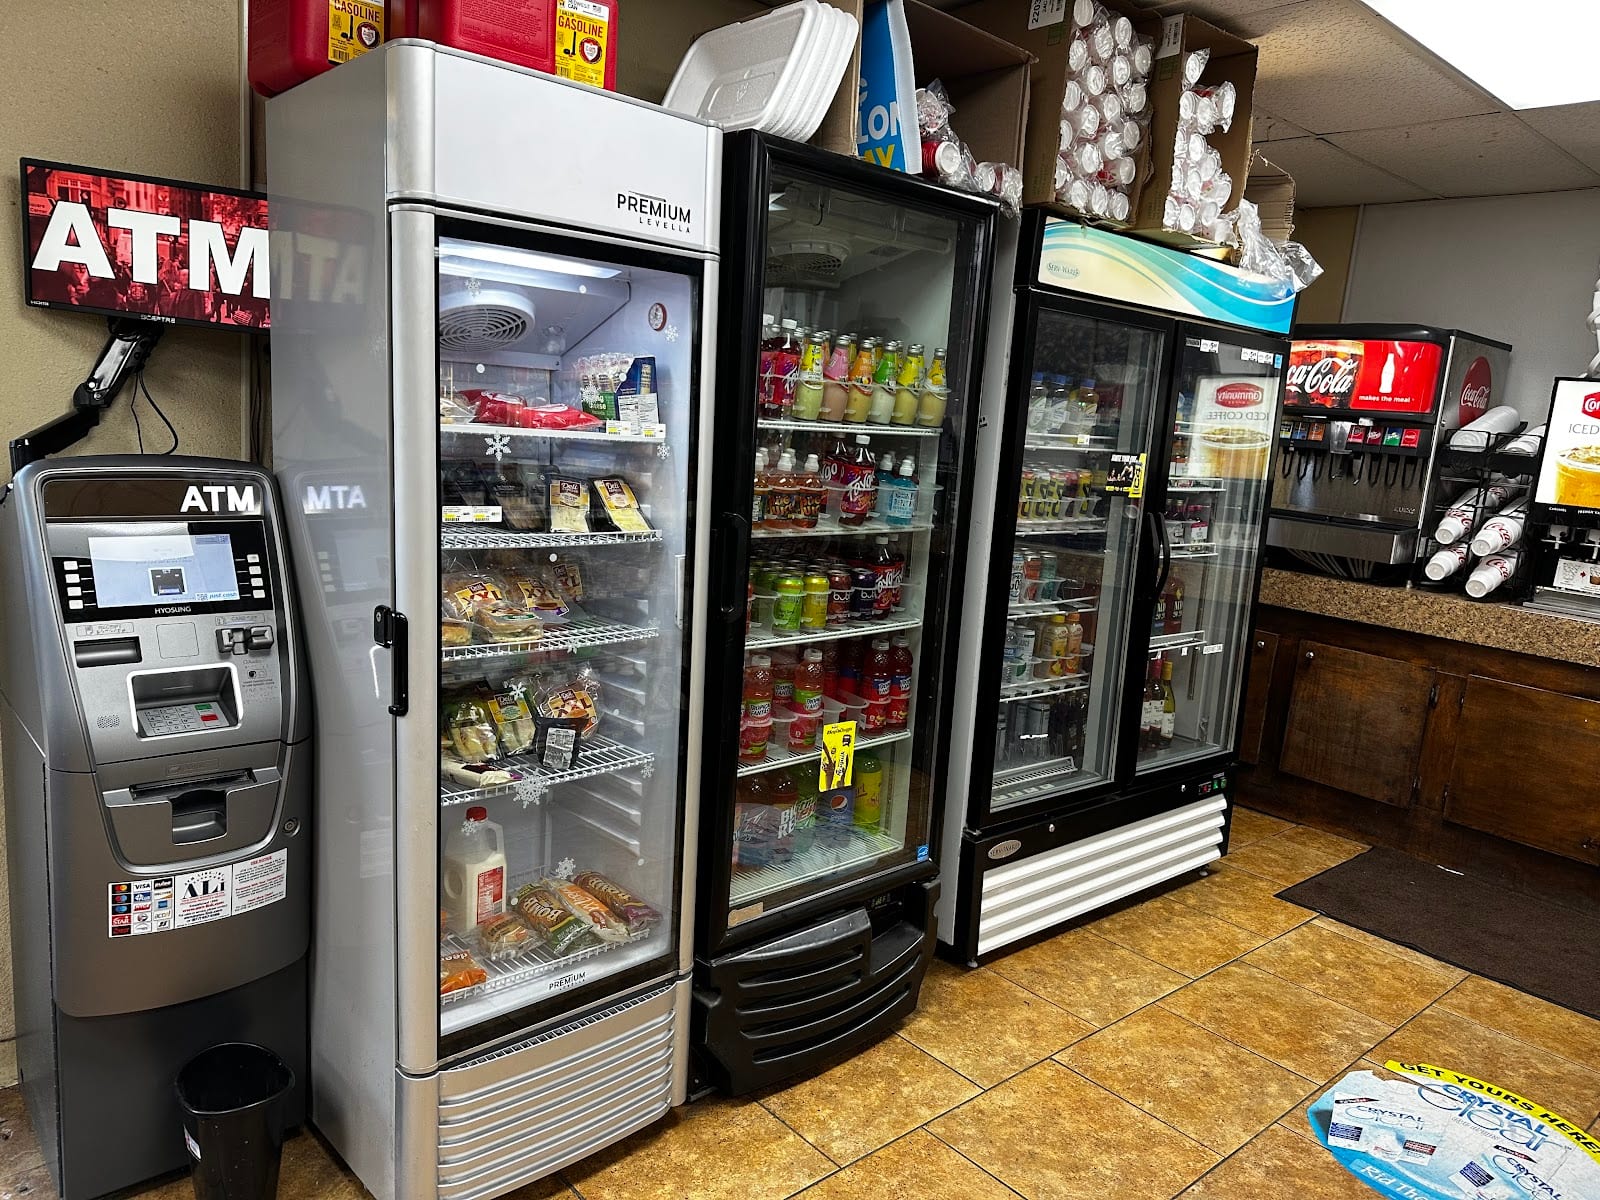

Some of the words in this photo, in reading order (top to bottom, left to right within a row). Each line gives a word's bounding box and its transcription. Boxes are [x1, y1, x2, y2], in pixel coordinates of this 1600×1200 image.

[558, 15, 604, 38] GASOLINE
[617, 192, 691, 224] PREMIUM
[639, 216, 691, 233] LEVELLA
[31, 200, 271, 300] ATM
[1286, 357, 1359, 394] ca-Cola
[1568, 423, 1600, 435] ICED
[561, 482, 579, 490] Deli
[606, 482, 620, 490] Deli
[179, 485, 255, 513] ATM
[154, 606, 192, 615] HYOSUNG
[523, 897, 565, 922] BOMB
[549, 971, 587, 990] PREMIUM
[1400, 1062, 1445, 1078] GET
[1453, 1074, 1535, 1112] YOURS
[1356, 1105, 1425, 1122] CRYSTAL
[1417, 1083, 1567, 1152] Clear
[1442, 1083, 1549, 1138] CRYSTAL
[1359, 1165, 1397, 1186] Rid
[1507, 1157, 1563, 1200] CRYSTAL
